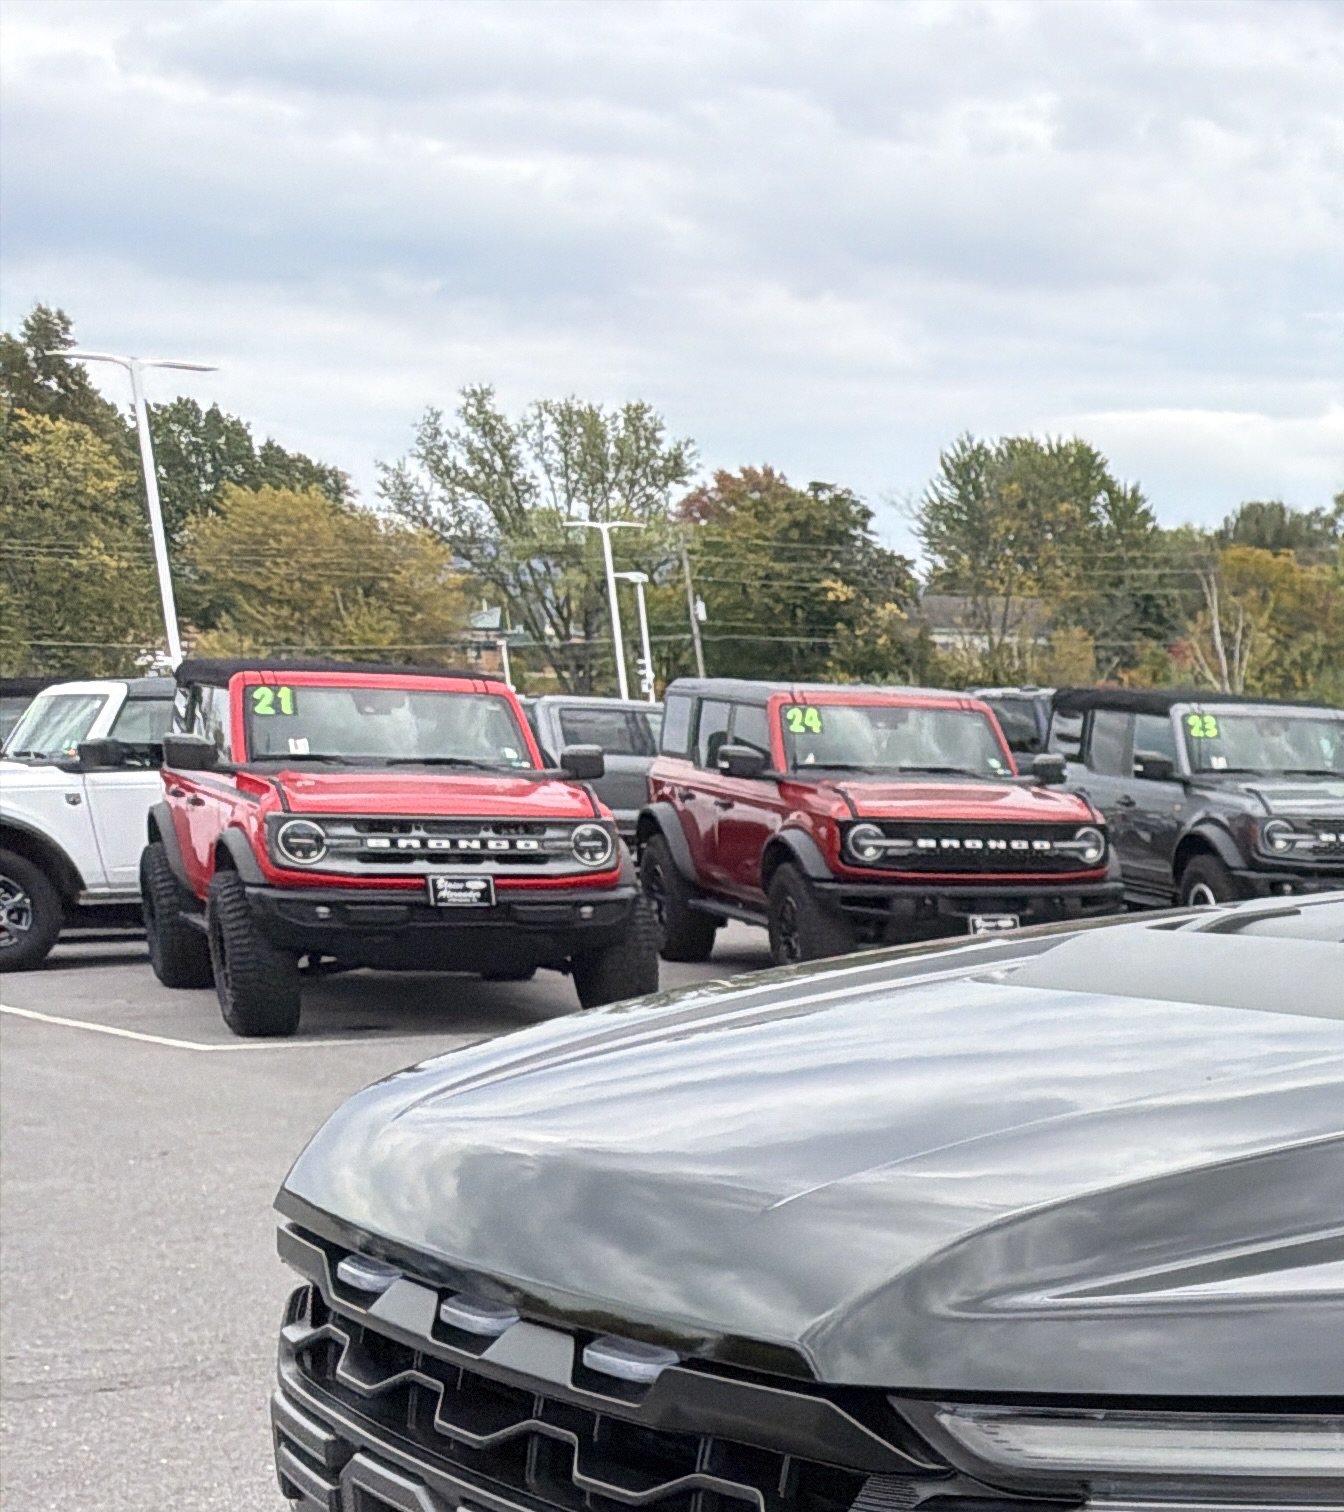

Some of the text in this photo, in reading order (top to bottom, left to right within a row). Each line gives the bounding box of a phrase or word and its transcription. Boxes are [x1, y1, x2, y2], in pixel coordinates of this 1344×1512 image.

[252, 686, 294, 715] 21
[786, 707, 821, 733] 24
[1187, 715, 1218, 738] 23
[366, 838, 539, 850] BRONCO
[916, 838, 1051, 850] BRONCO
